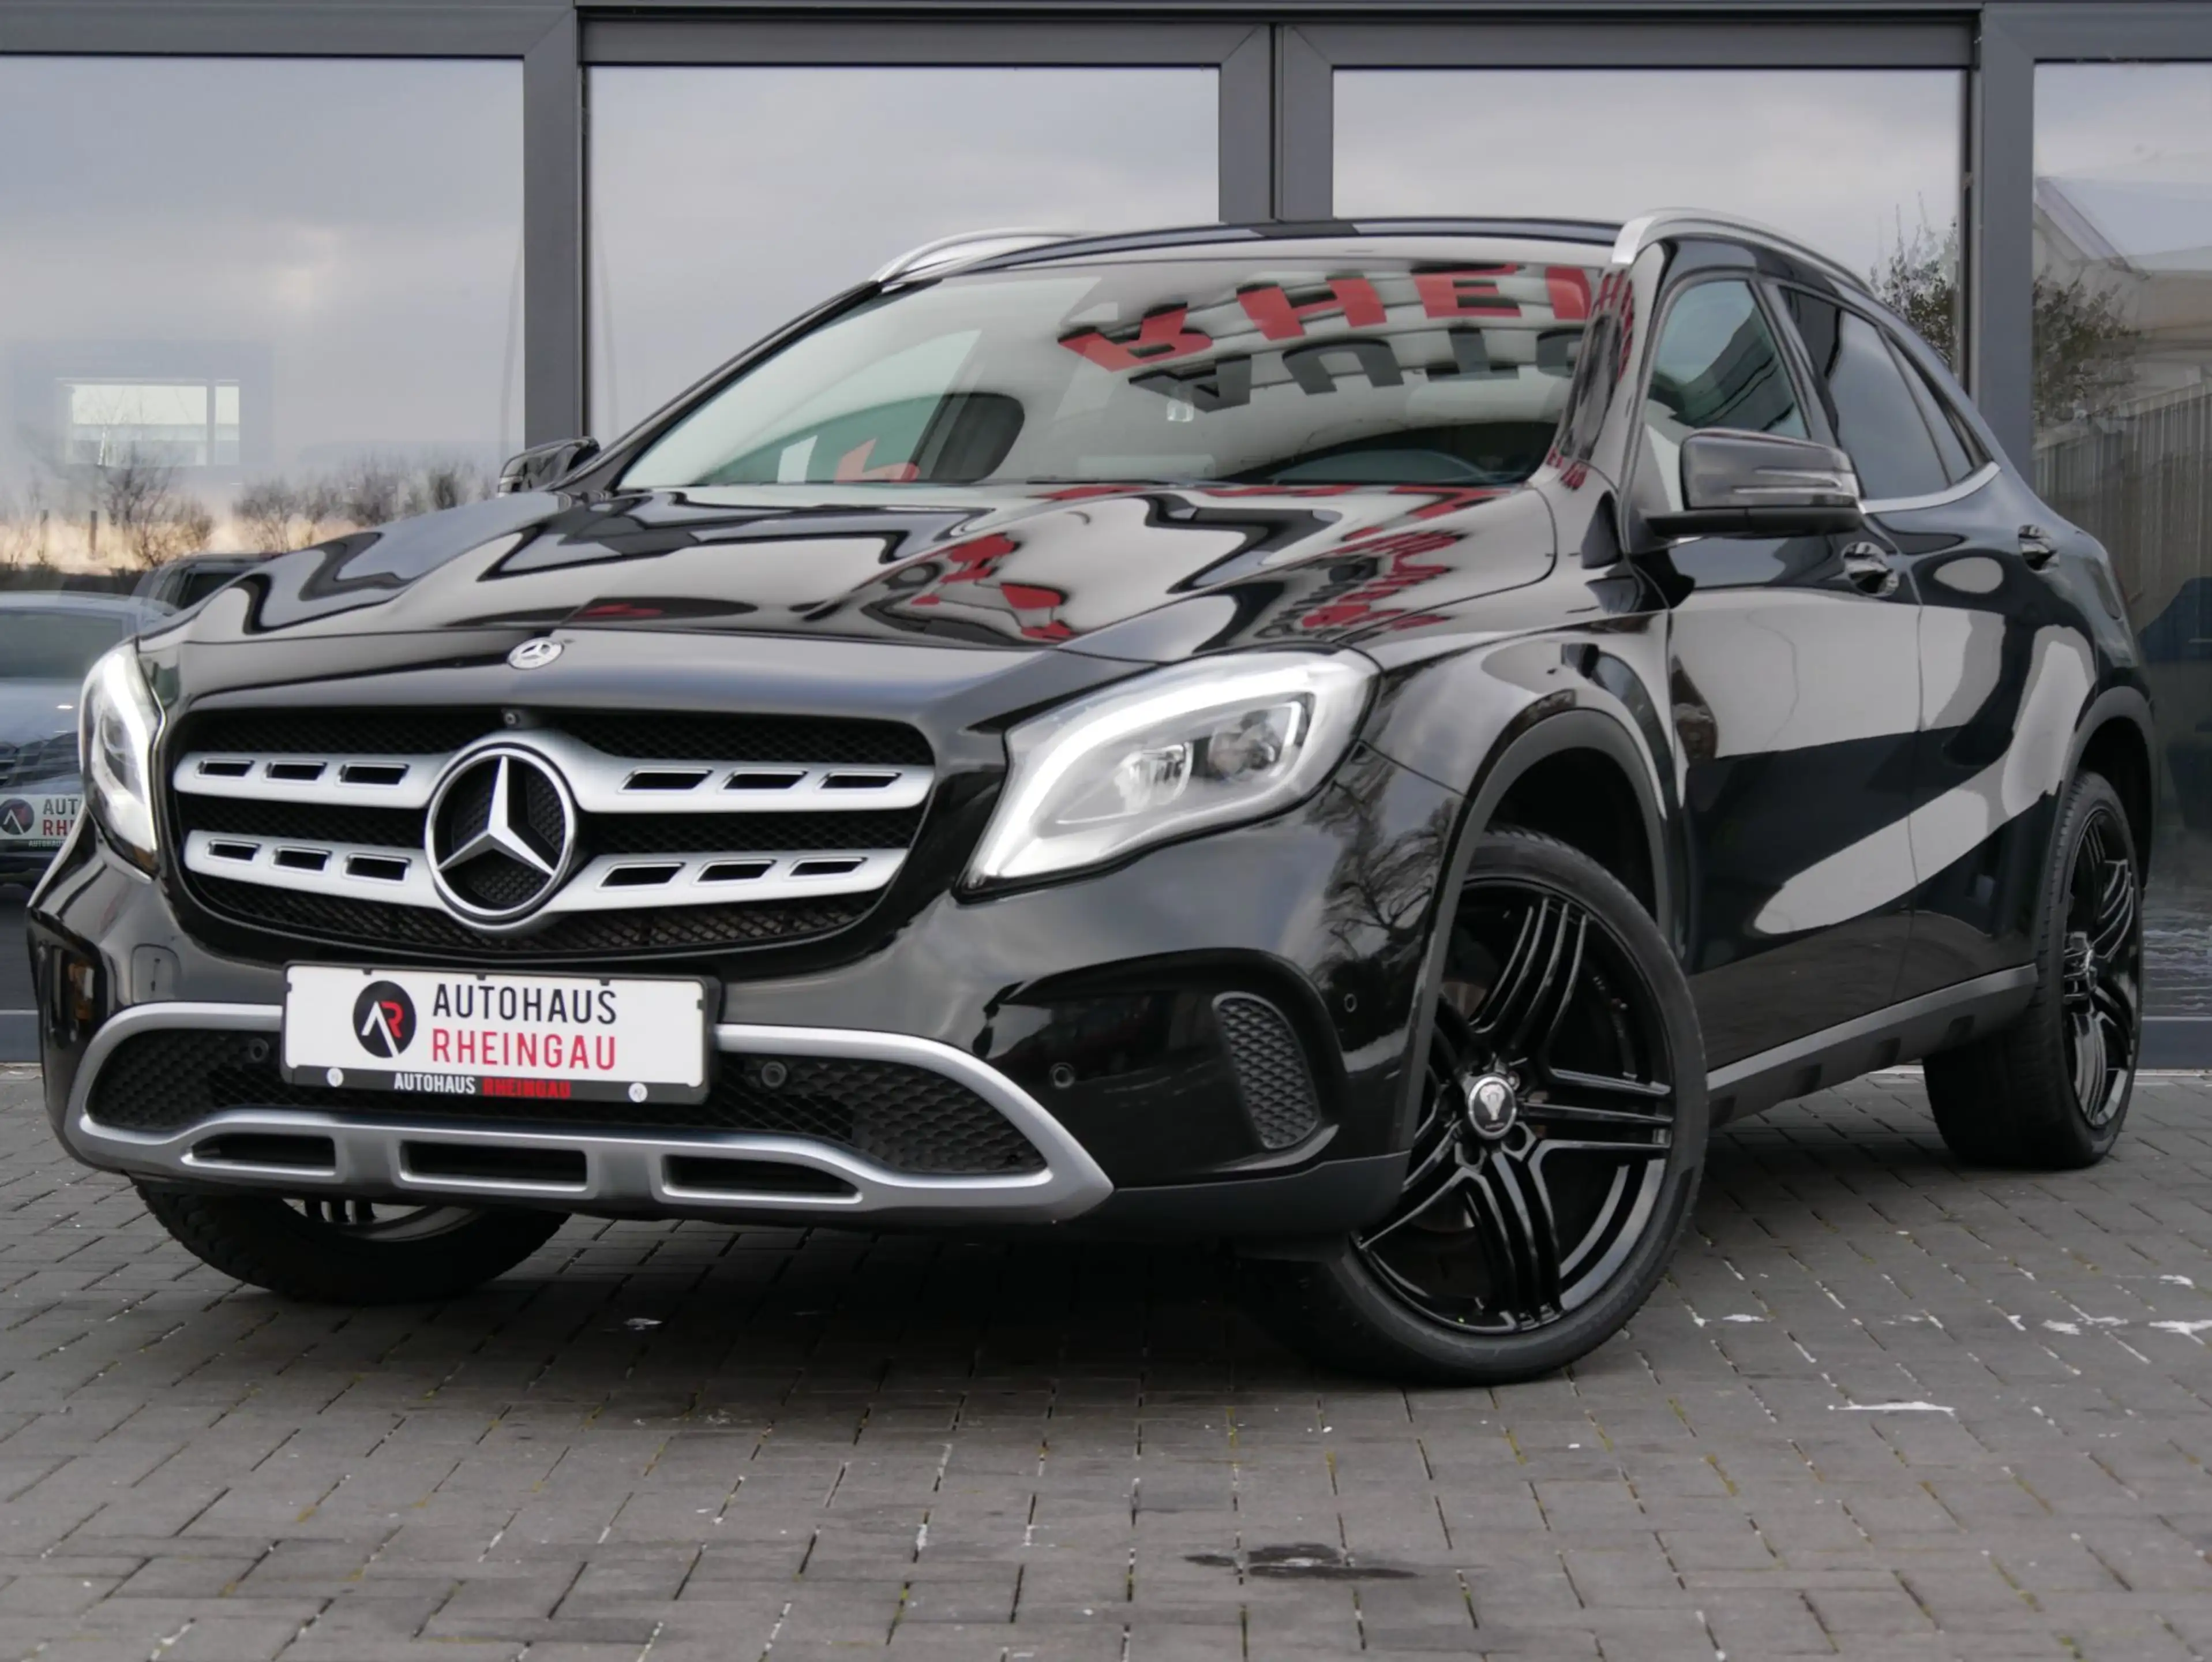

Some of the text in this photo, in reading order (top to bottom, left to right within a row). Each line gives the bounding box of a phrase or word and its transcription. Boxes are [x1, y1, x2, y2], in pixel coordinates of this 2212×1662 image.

[43, 799, 80, 815] AUT
[433, 983, 616, 1024] AUTOHAUS
[433, 1028, 615, 1070] RHEINGAU
[394, 1073, 571, 1099] AUTOHAUS RHEINGAU
